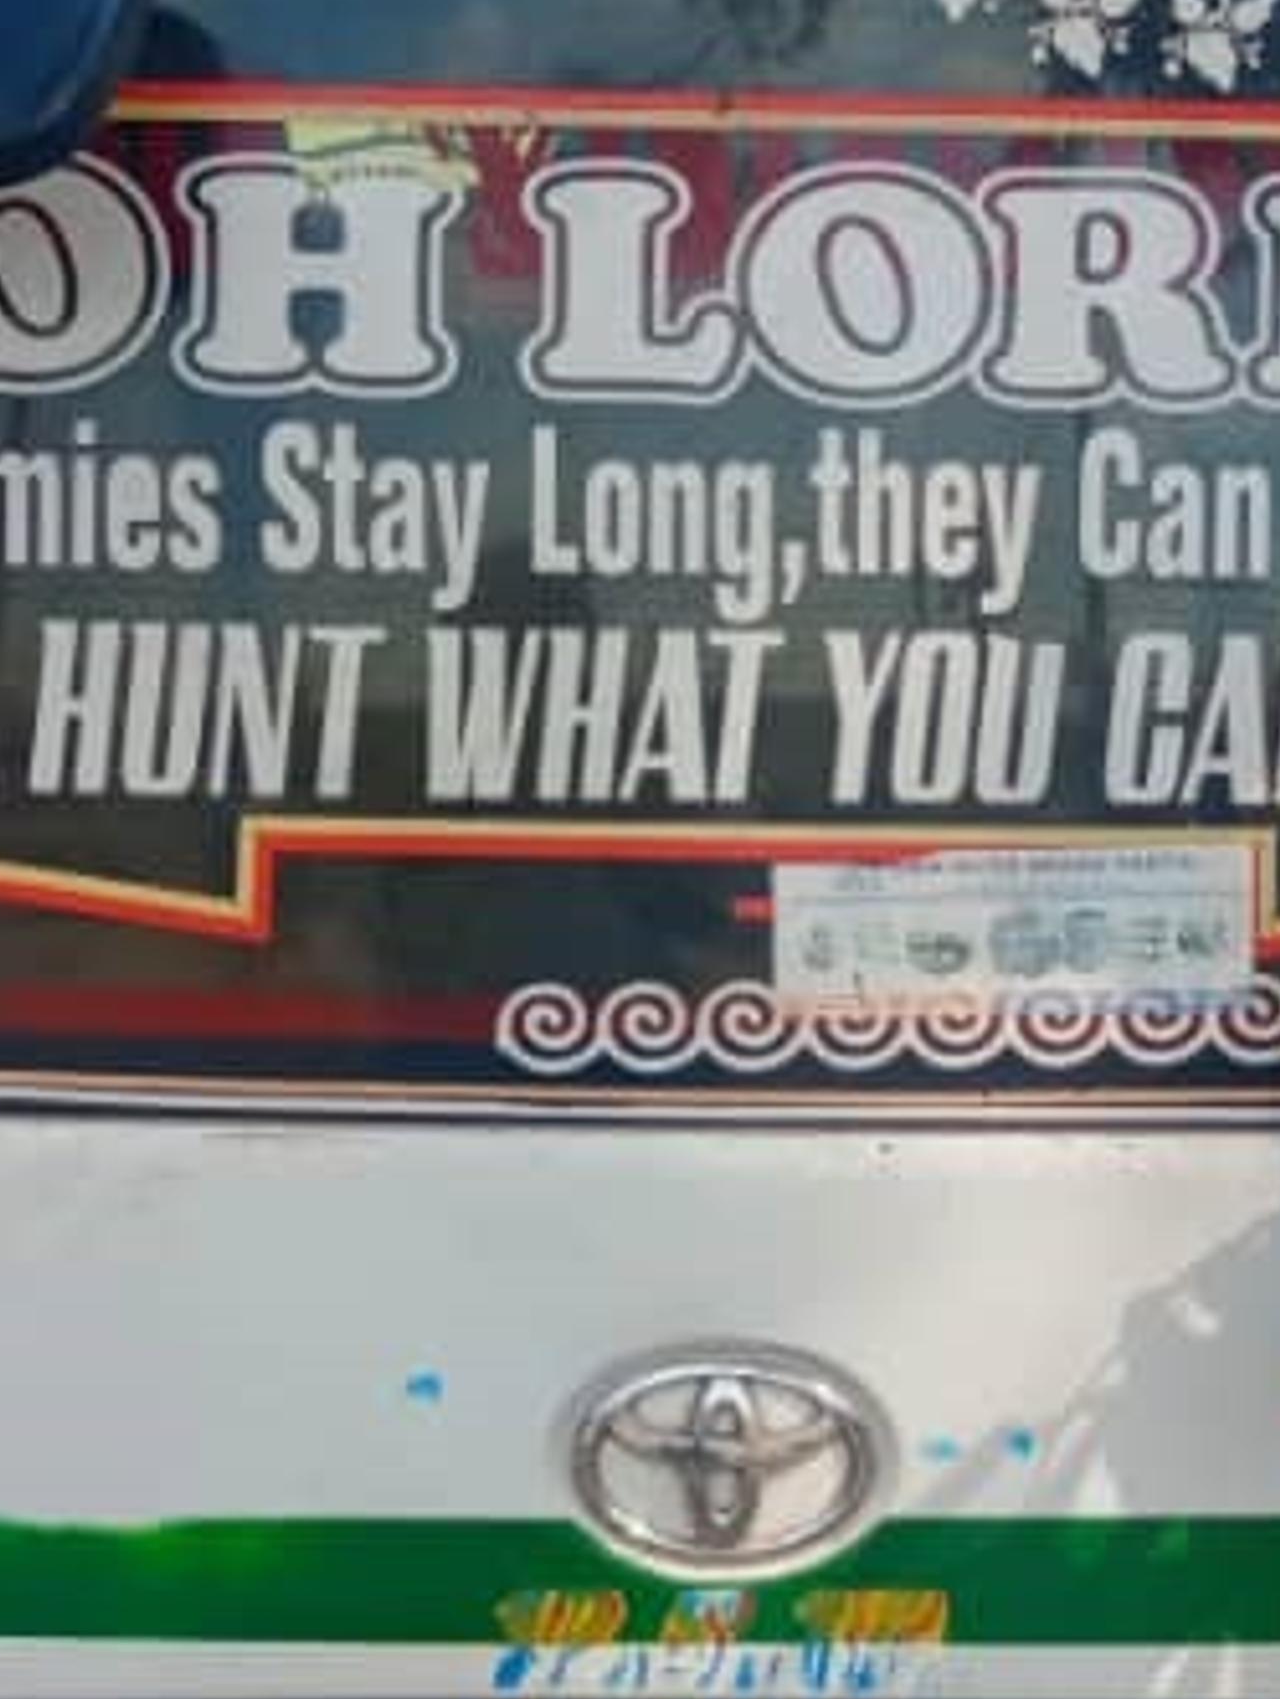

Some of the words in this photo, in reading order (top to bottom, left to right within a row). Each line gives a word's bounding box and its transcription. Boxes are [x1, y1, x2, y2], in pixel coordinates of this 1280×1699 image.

[260, 422, 488, 610] Stay
[1080, 428, 1272, 582] Can
[28, 622, 388, 800] HUNT
[424, 626, 784, 806] WHAT
[822, 632, 1064, 808] YOU
